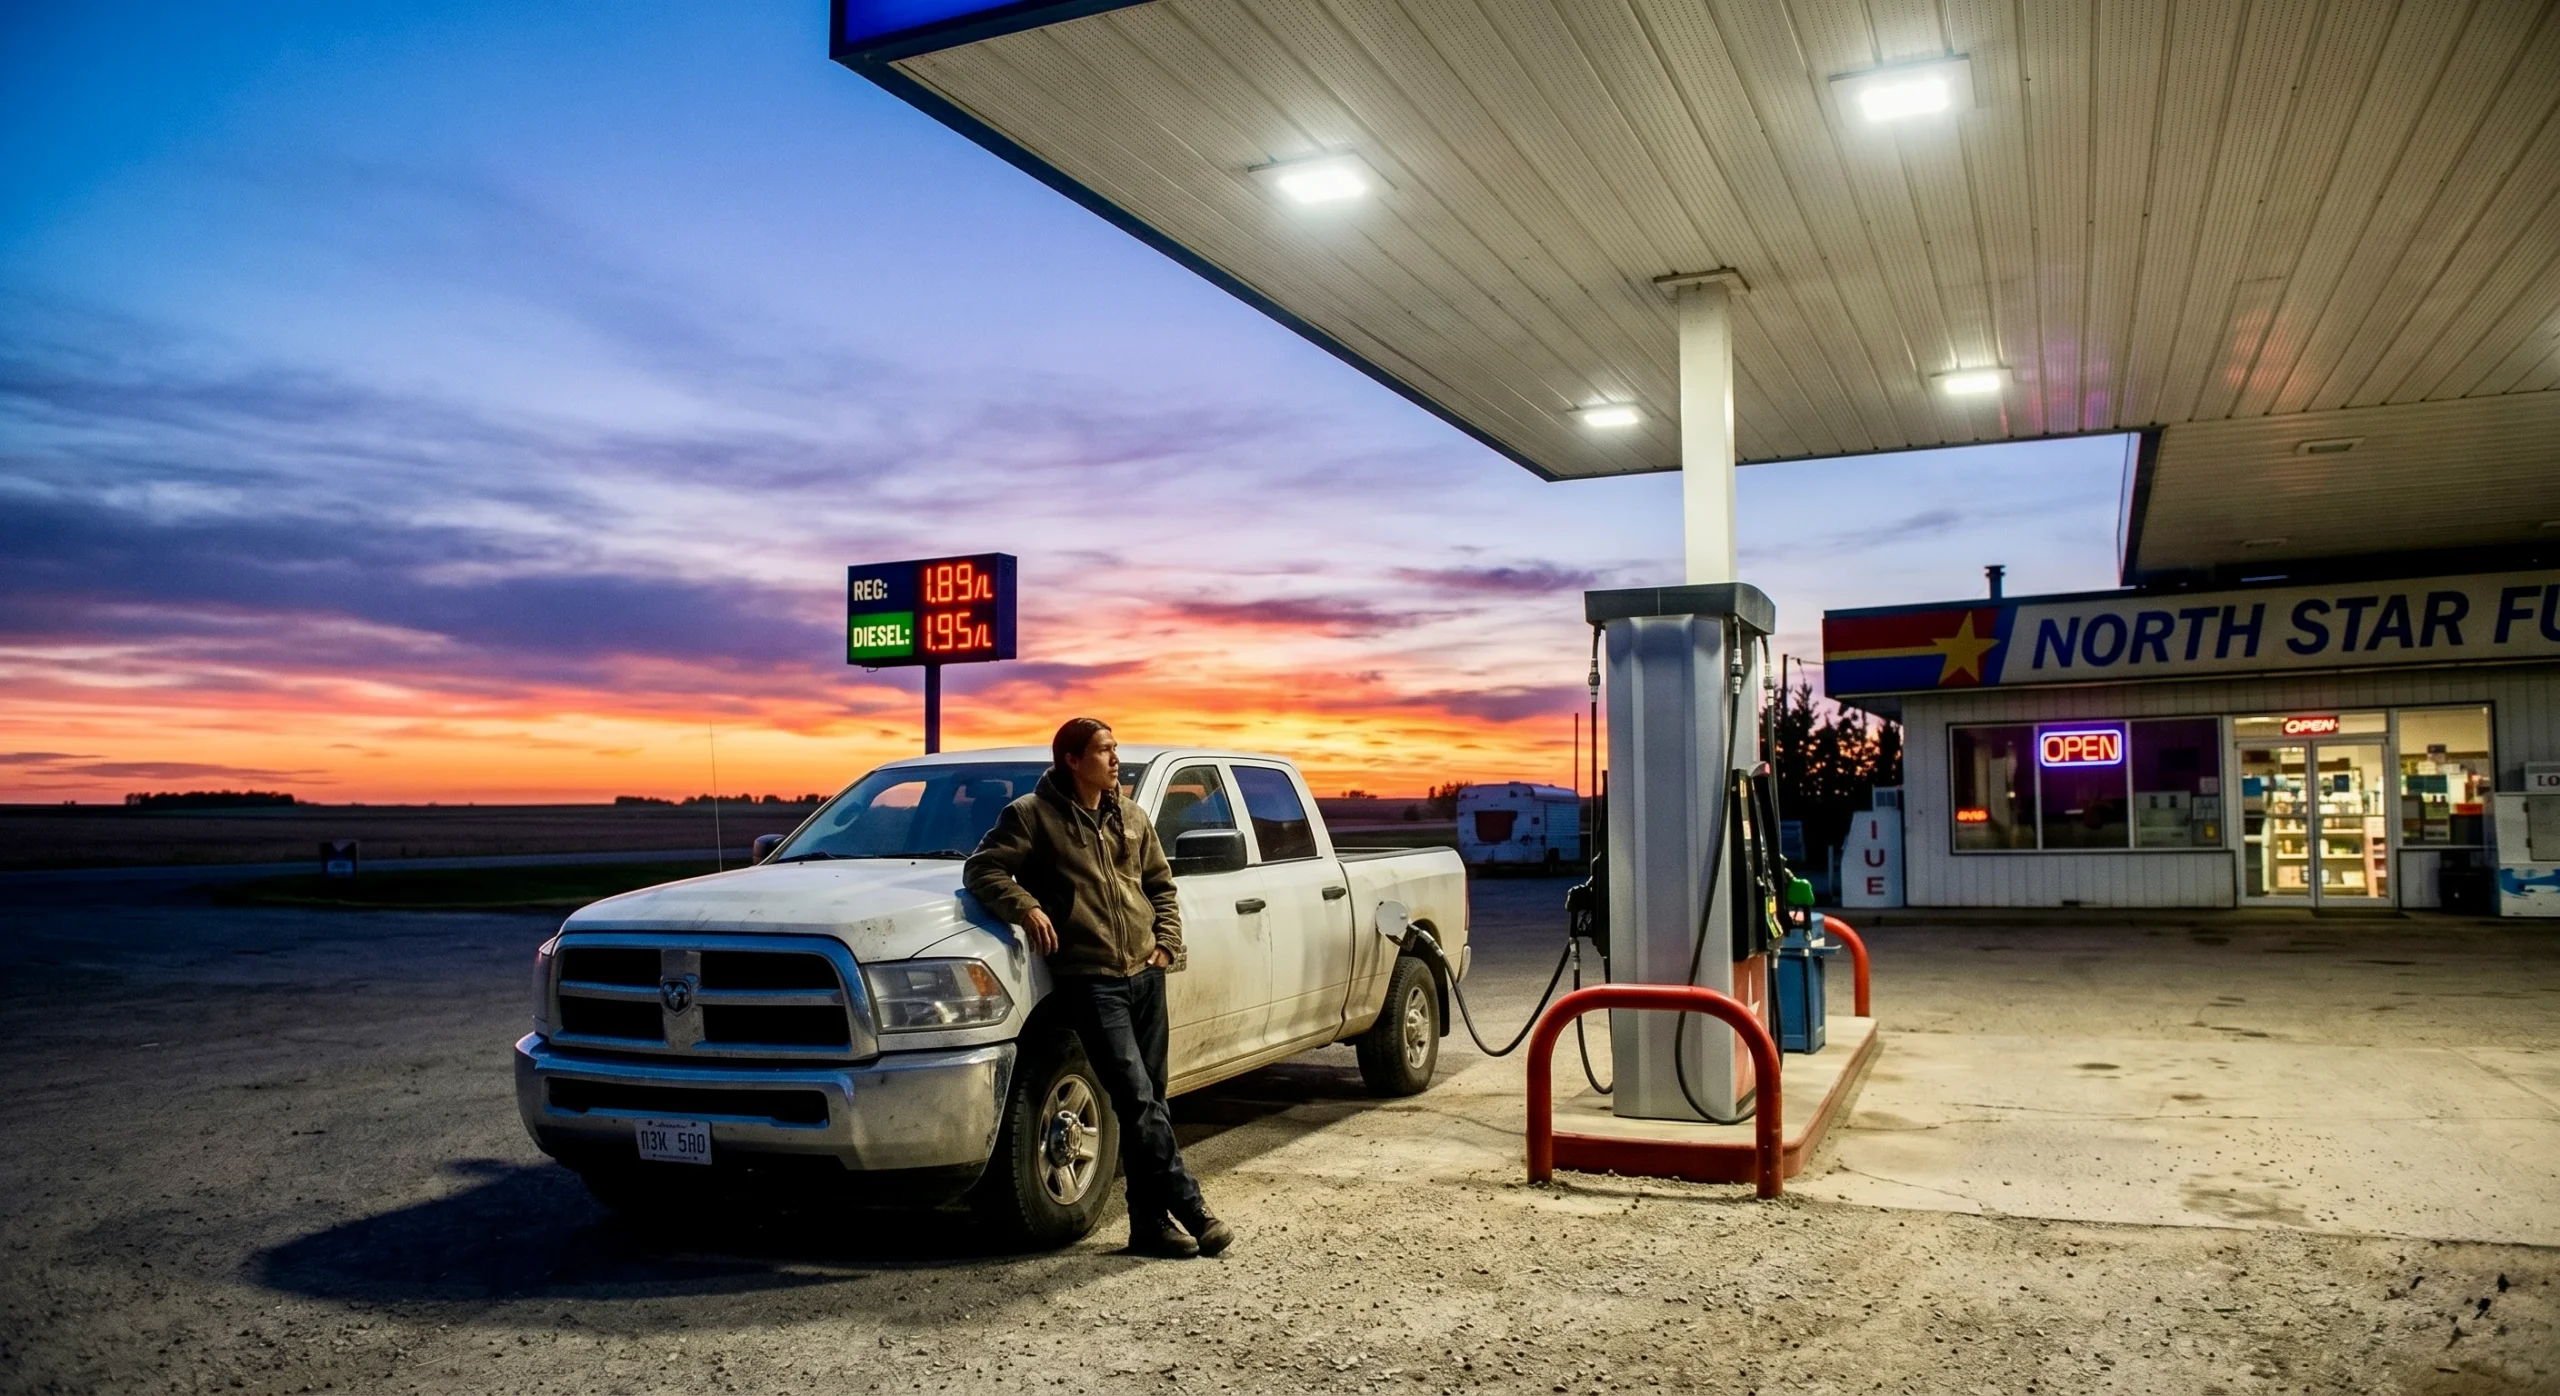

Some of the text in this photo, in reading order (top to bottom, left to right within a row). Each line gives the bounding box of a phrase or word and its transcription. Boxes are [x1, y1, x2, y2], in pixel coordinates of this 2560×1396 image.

[853, 564, 993, 604] REG: 1.89/L
[853, 612, 992, 651] DIESEL: 1.95/L
[2031, 603, 2266, 670] NORTH
[2286, 590, 2470, 656] STAR
[2284, 718, 2335, 734] OPEN
[2043, 735, 2119, 762] OPEN
